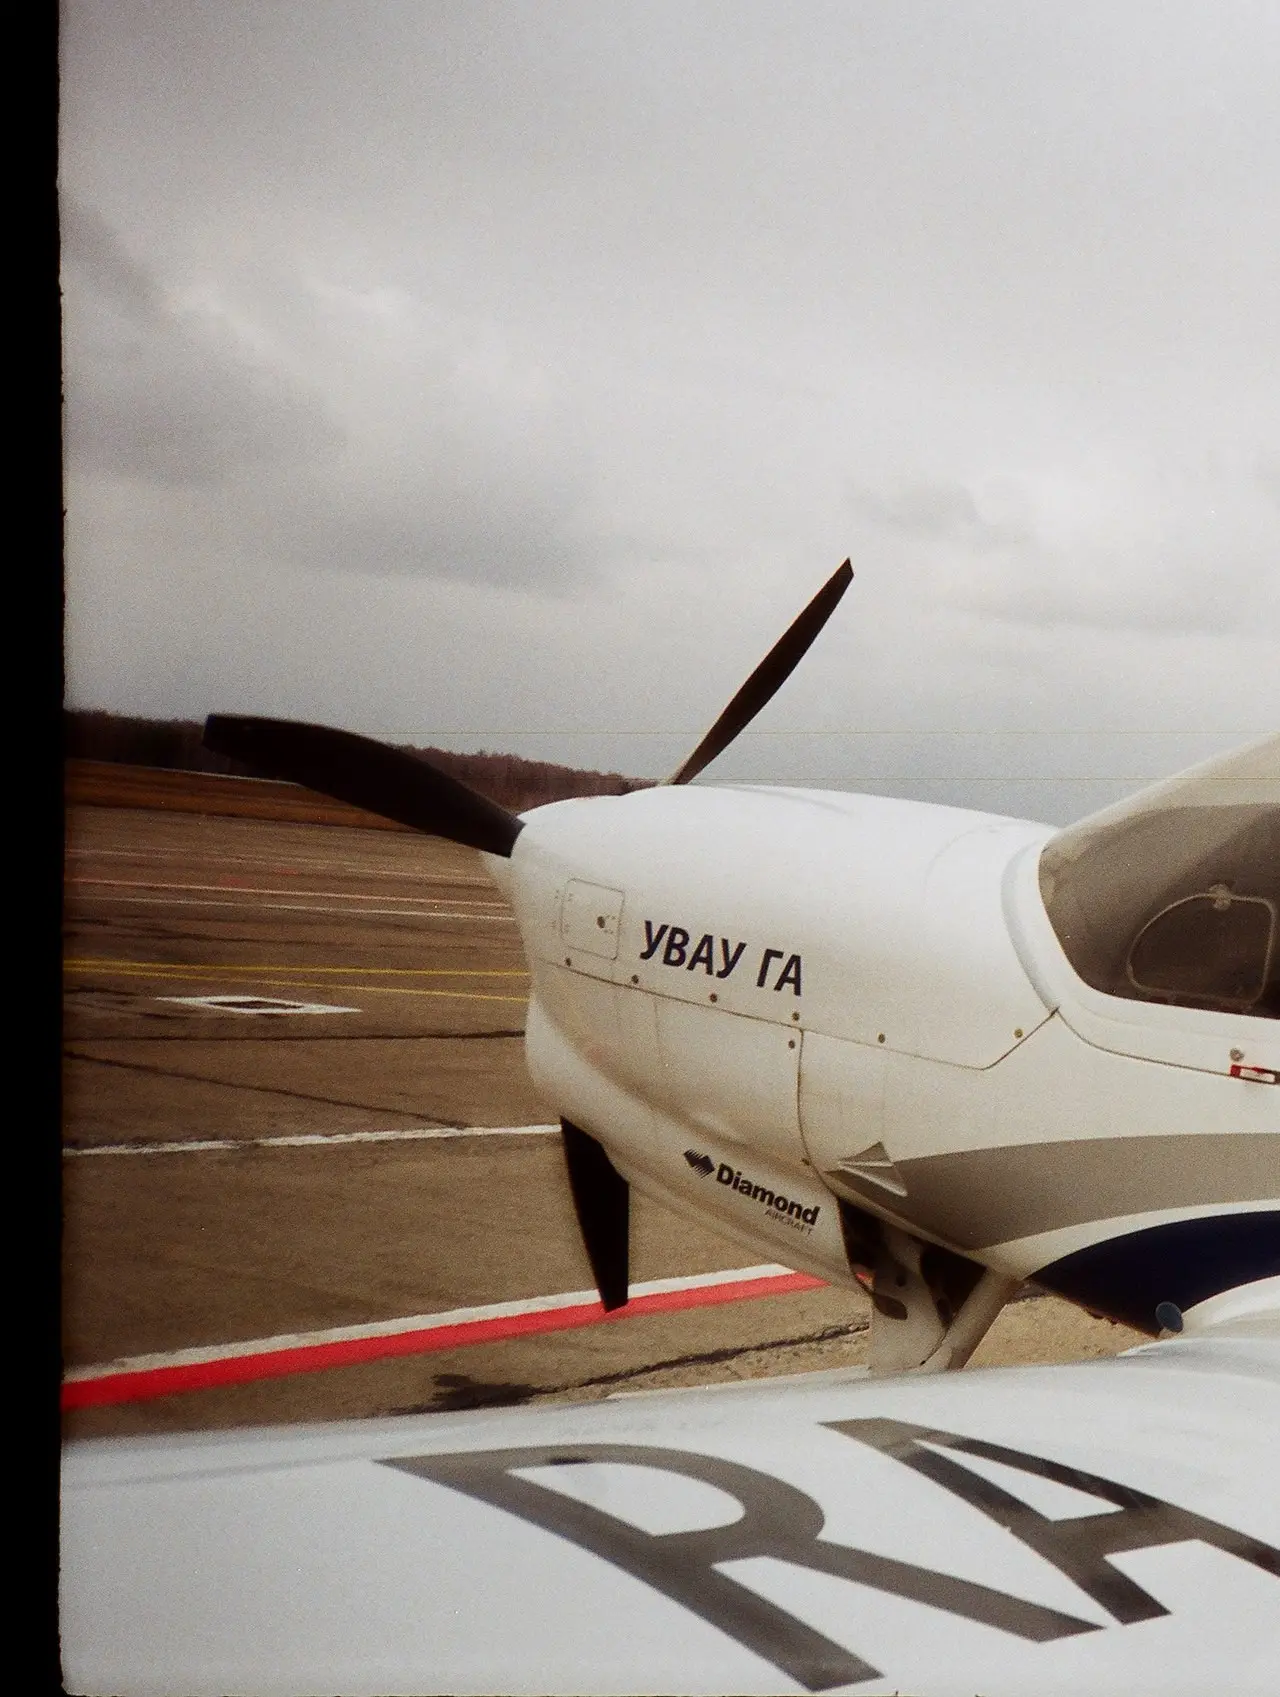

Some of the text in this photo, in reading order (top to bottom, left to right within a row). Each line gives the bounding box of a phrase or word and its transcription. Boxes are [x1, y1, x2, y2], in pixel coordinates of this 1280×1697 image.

[639, 919, 802, 997] УВАУ ГА
[716, 1162, 821, 1226] Diamond
